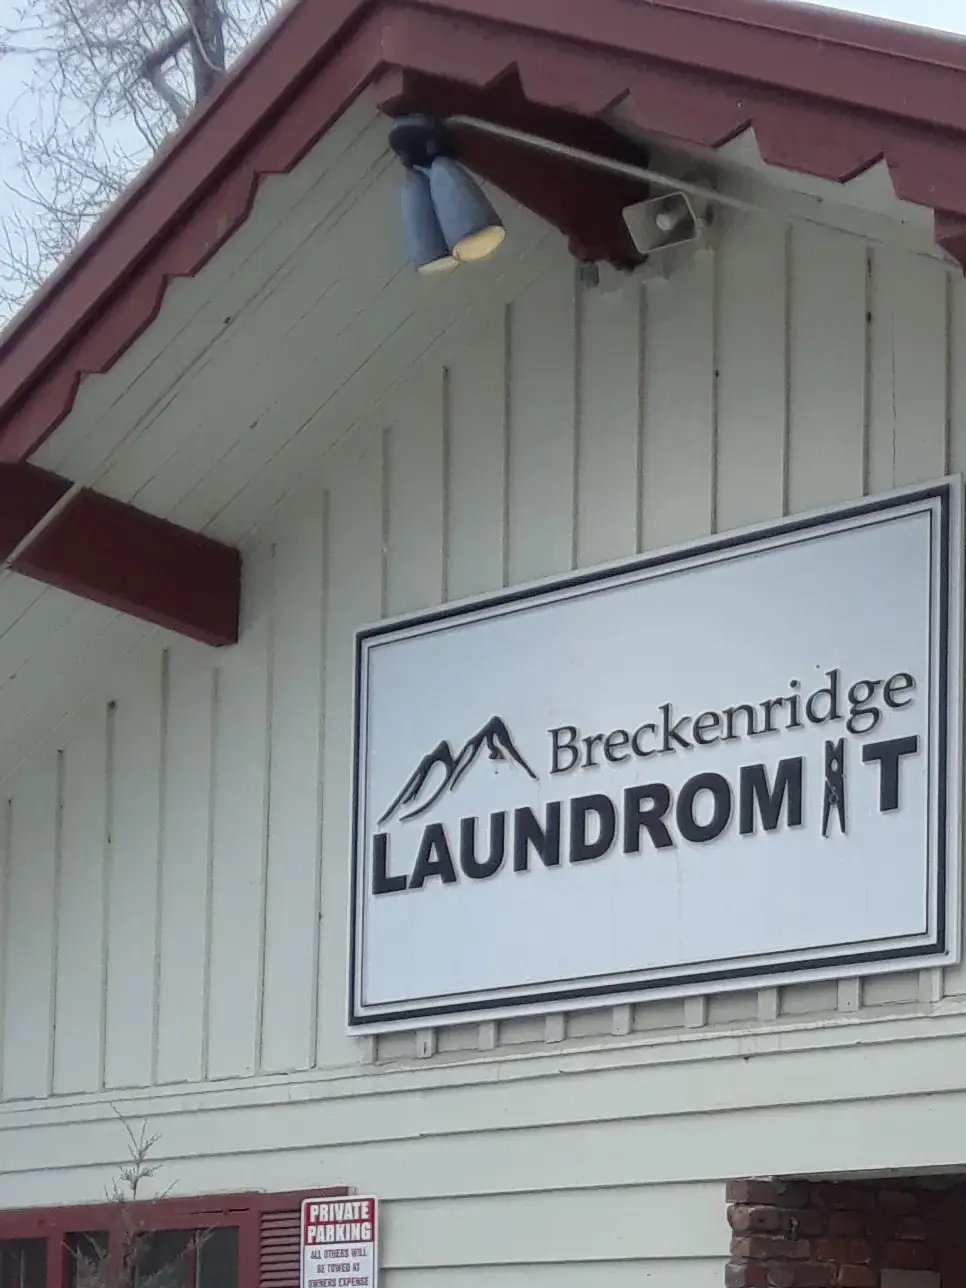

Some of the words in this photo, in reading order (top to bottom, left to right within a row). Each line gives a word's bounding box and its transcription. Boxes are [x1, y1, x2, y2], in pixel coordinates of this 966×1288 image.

[547, 668, 915, 775] Breckenridge
[309, 1201, 369, 1223] PRIVATE
[307, 1222, 372, 1244] PARKING
[310, 1249, 322, 1260] ALL
[323, 1248, 349, 1259] OTHERS
[351, 1247, 368, 1257] WILL
[316, 1263, 326, 1274] BE
[327, 1262, 351, 1273] TOWED
[352, 1262, 360, 1272] AT
[308, 1278, 337, 1288] OWNERS
[338, 1276, 369, 1287] EXPENSE
